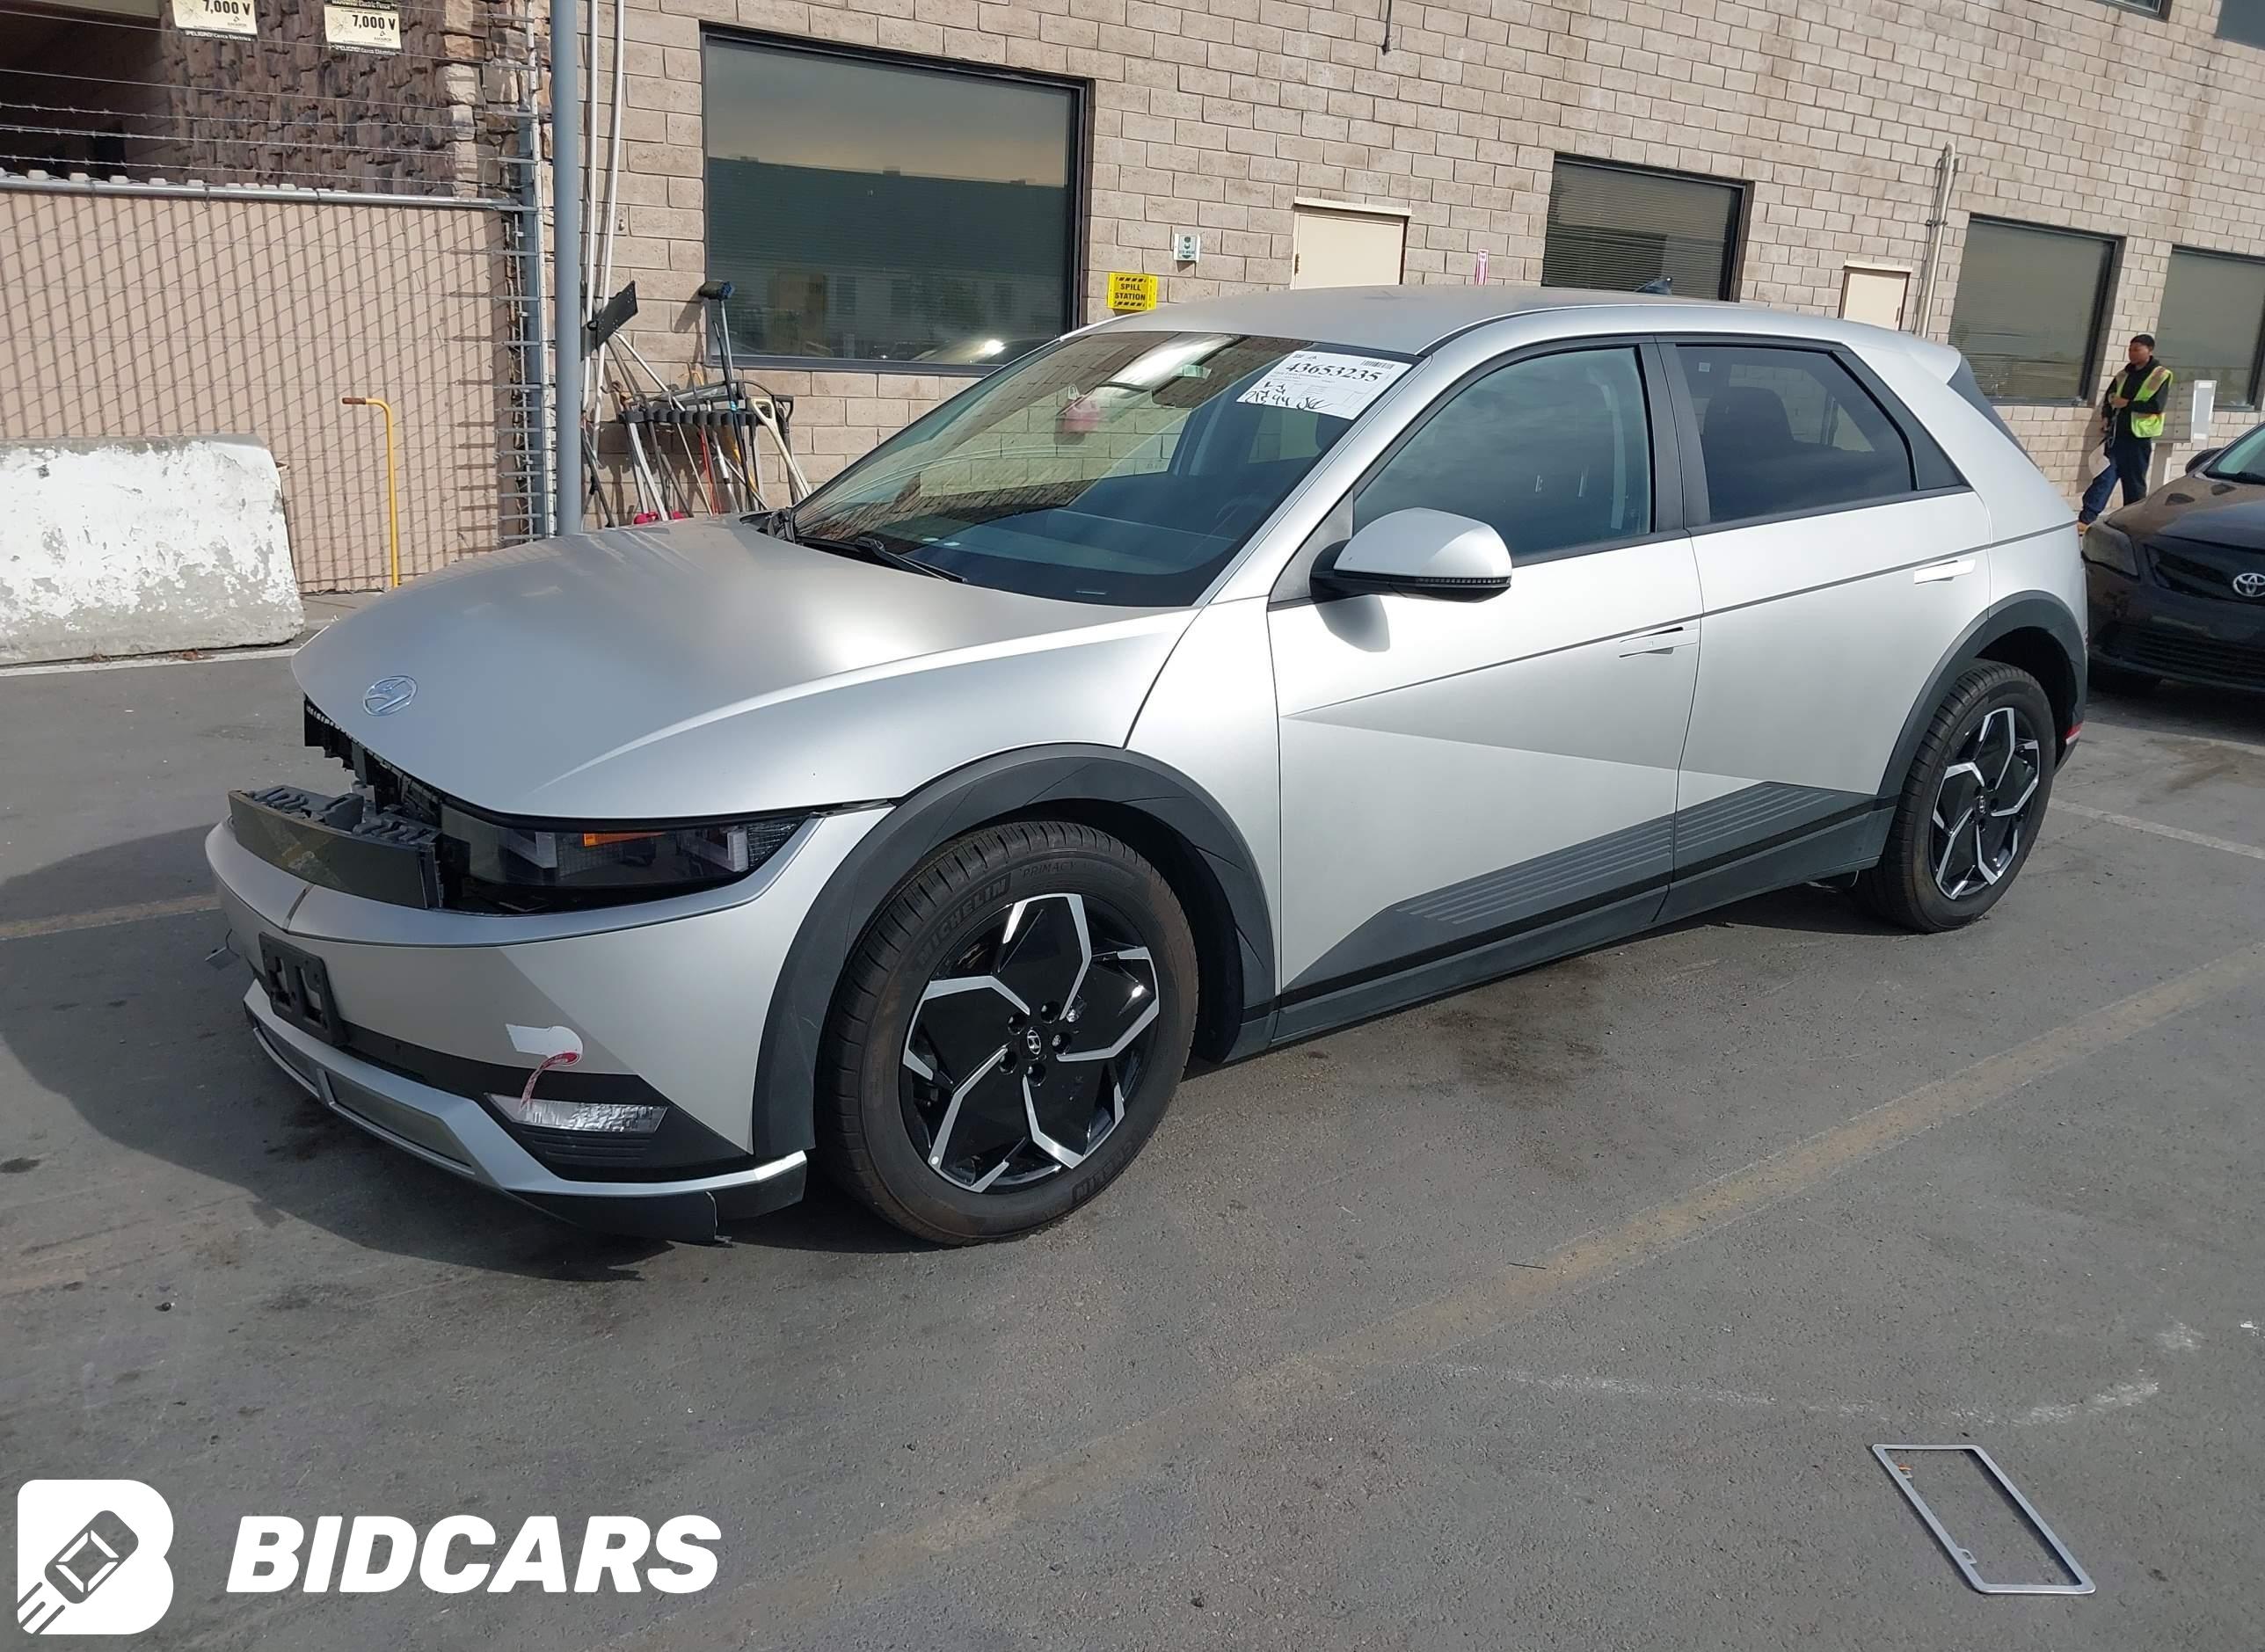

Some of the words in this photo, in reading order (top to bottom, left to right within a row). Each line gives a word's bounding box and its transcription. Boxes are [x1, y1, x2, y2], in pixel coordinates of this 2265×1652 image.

[203, 0, 239, 14] 7,000
[243, 3, 251, 16] V
[352, 14, 385, 29] 7,000
[388, 18, 396, 31] V
[1115, 292, 1146, 301] STATION
[1285, 362, 1383, 382] 43653235
[916, 877, 1009, 970] MICHELIN
